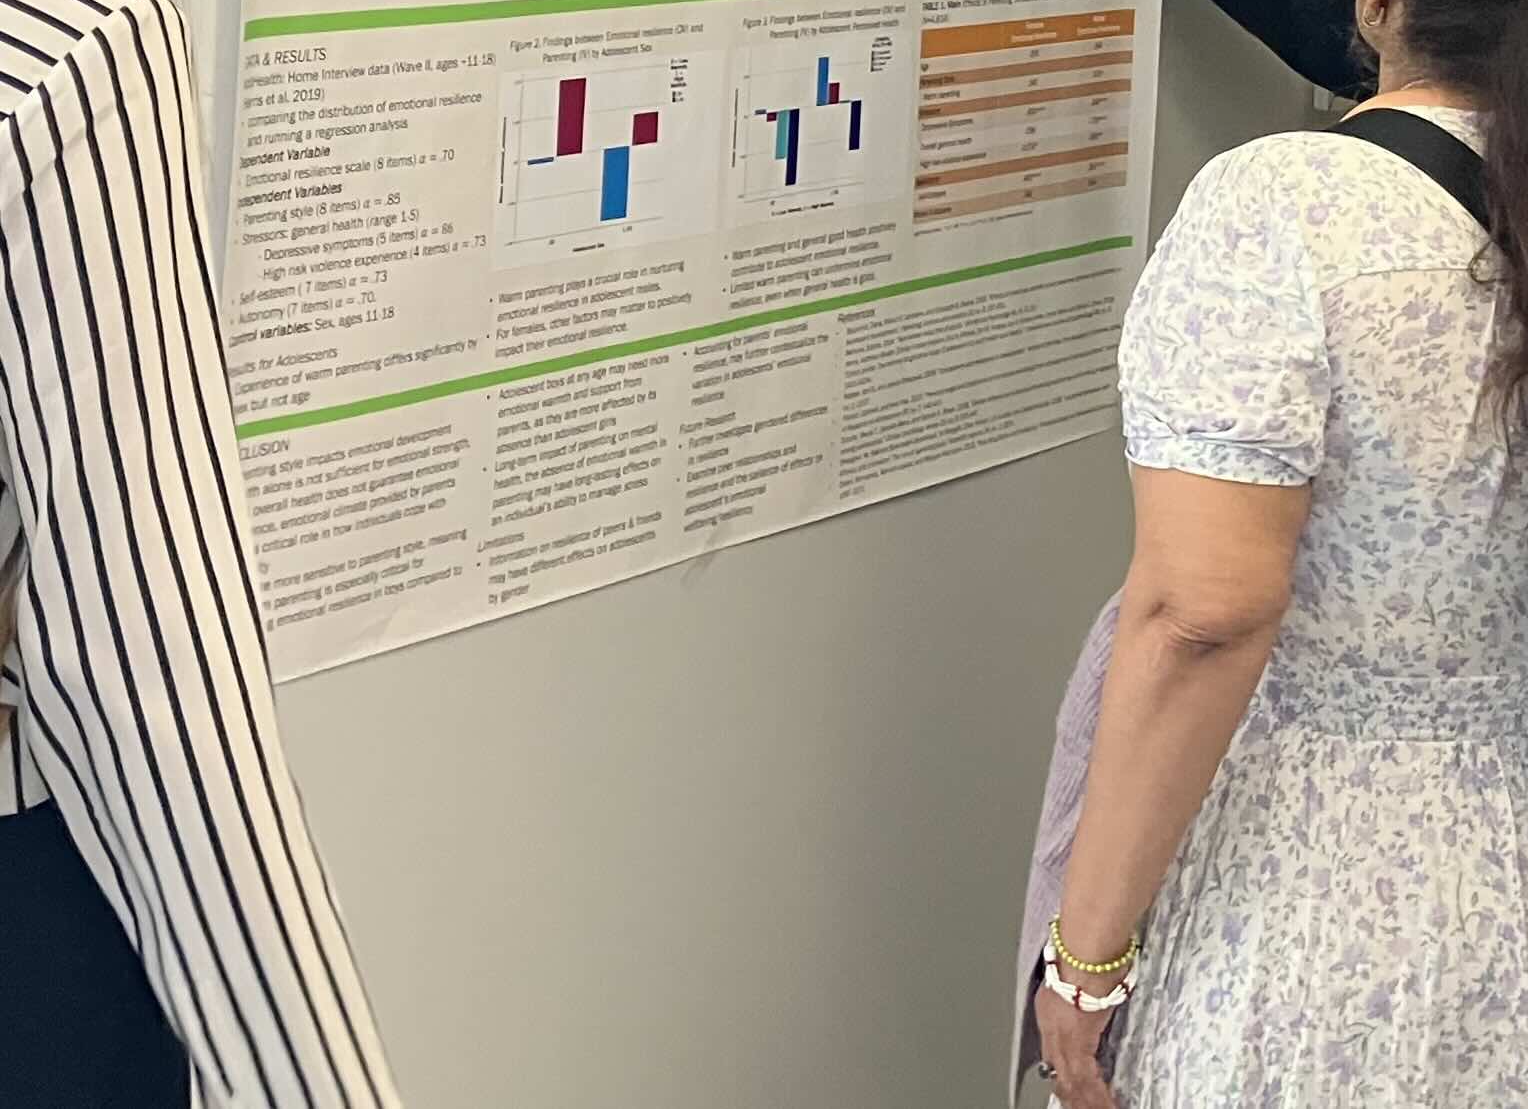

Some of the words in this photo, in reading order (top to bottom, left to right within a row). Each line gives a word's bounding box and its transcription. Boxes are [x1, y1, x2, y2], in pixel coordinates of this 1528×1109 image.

[274, 48, 326, 64] RESULTS
[288, 73, 318, 83] Home
[322, 69, 365, 80] Interview
[368, 64, 390, 75] data
[436, 59, 458, 71] ages
[299, 110, 315, 121] the
[318, 104, 373, 118] distribution
[376, 101, 386, 112] of
[389, 98, 437, 111] emotional
[315, 124, 369, 139] regression
[287, 146, 330, 160] Variable
